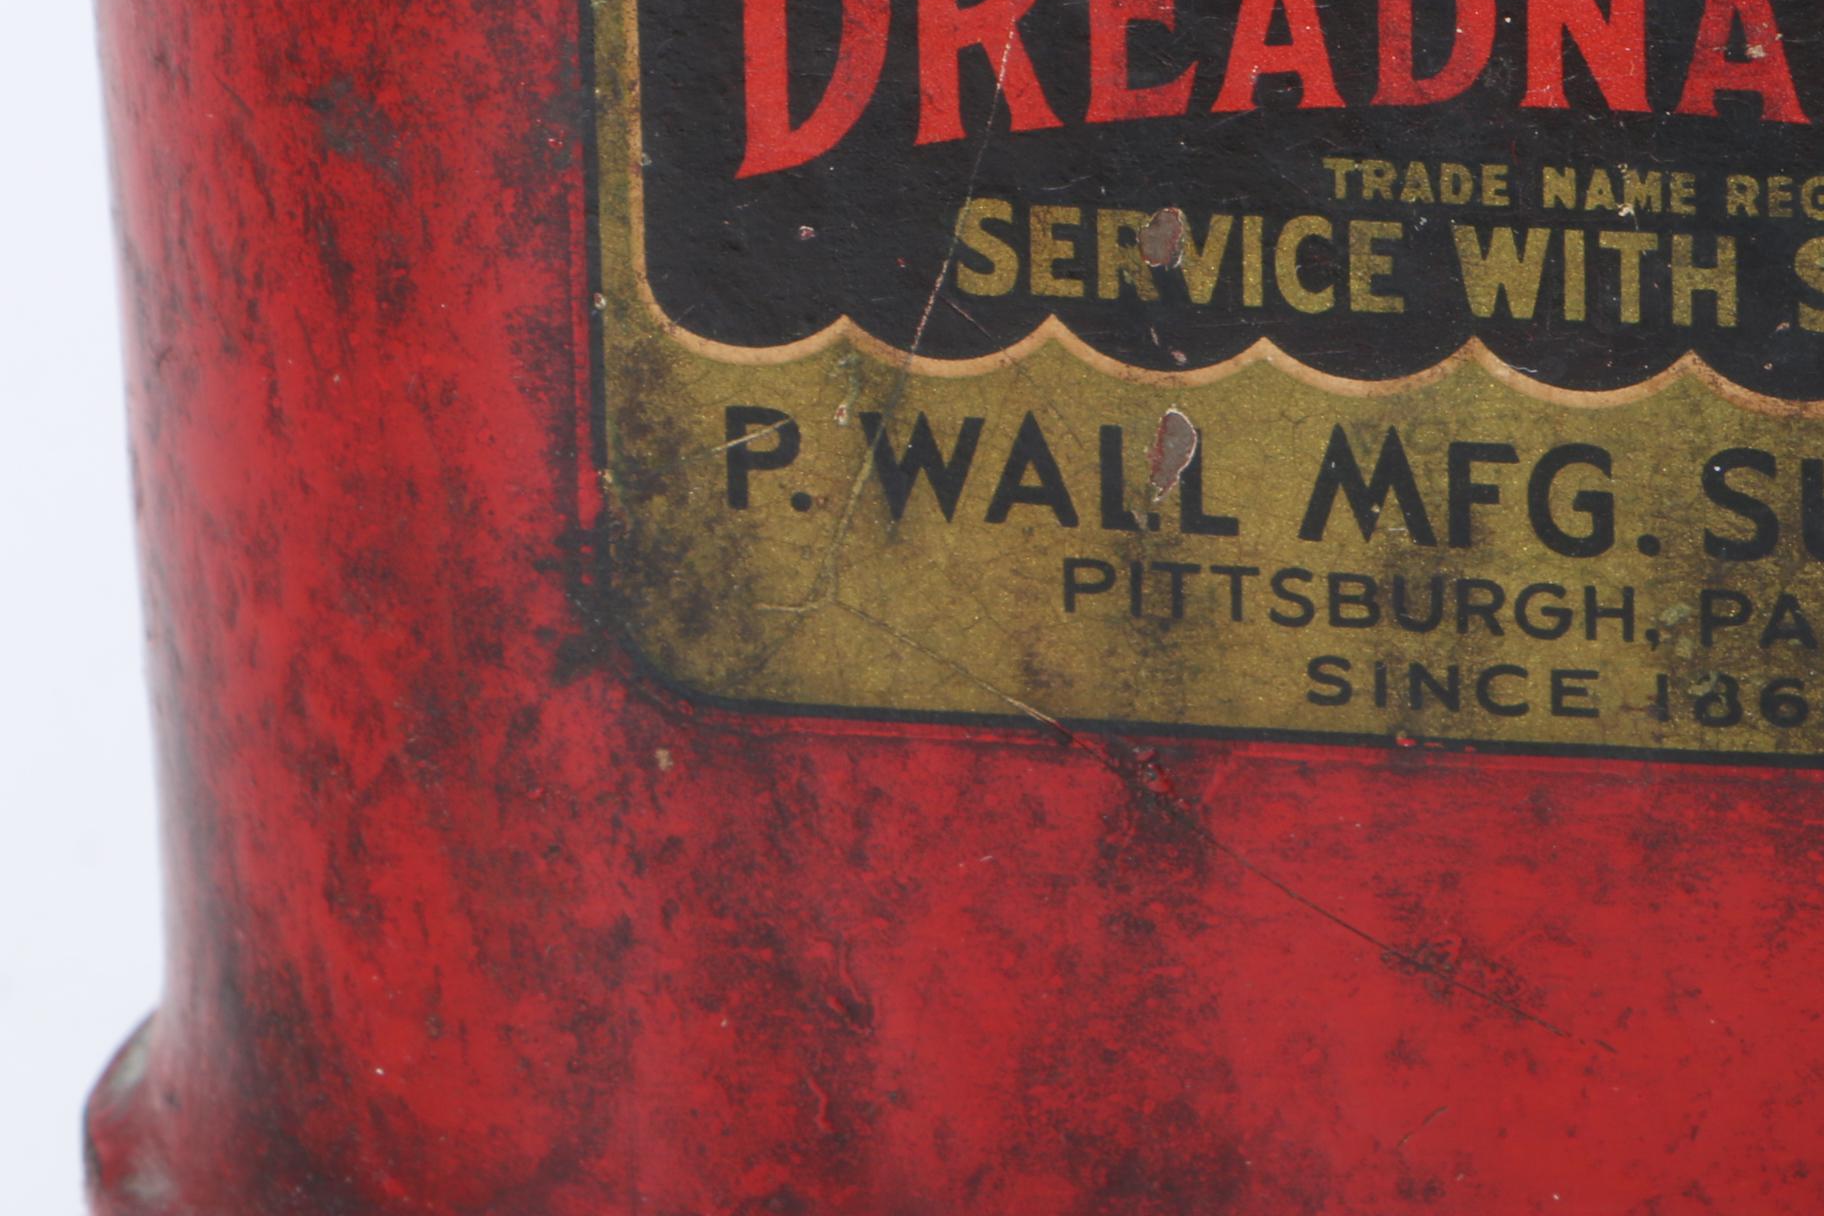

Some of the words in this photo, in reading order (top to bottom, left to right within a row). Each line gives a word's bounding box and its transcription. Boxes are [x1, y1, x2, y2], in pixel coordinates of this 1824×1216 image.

[1322, 157, 1510, 207] TRADE
[1543, 166, 1696, 216] NAME
[955, 197, 1405, 315] SERVICE
[1451, 224, 1739, 328] WITH
[724, 404, 814, 513] P.
[859, 410, 1240, 538] WALL
[1298, 424, 1662, 558] MFG.
[1064, 557, 1660, 651] PITTSBURGH,
[1307, 654, 1600, 720] SINCE
